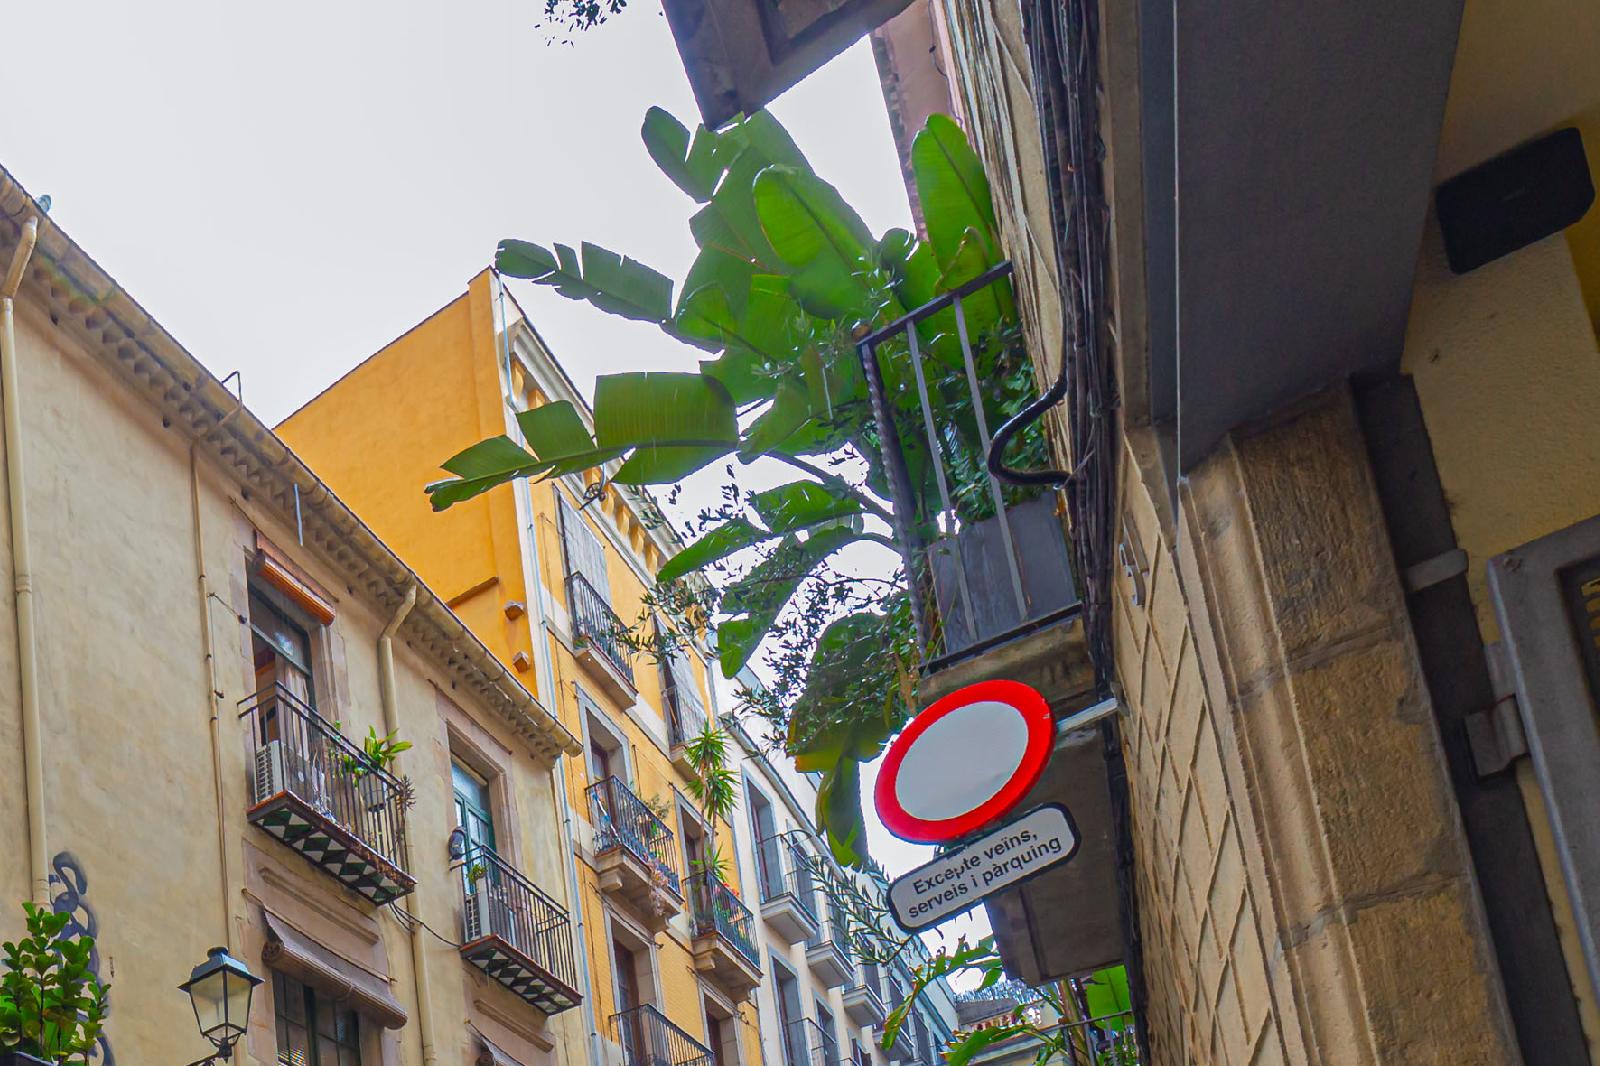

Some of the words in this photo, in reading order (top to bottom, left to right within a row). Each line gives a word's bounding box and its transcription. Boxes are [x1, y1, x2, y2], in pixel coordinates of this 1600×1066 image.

[908, 882, 969, 919] serveis
[971, 874, 979, 888] i
[982, 837, 1062, 887] pàrquing
[913, 855, 981, 895] Excepte
[984, 829, 1038, 860] veïns,
